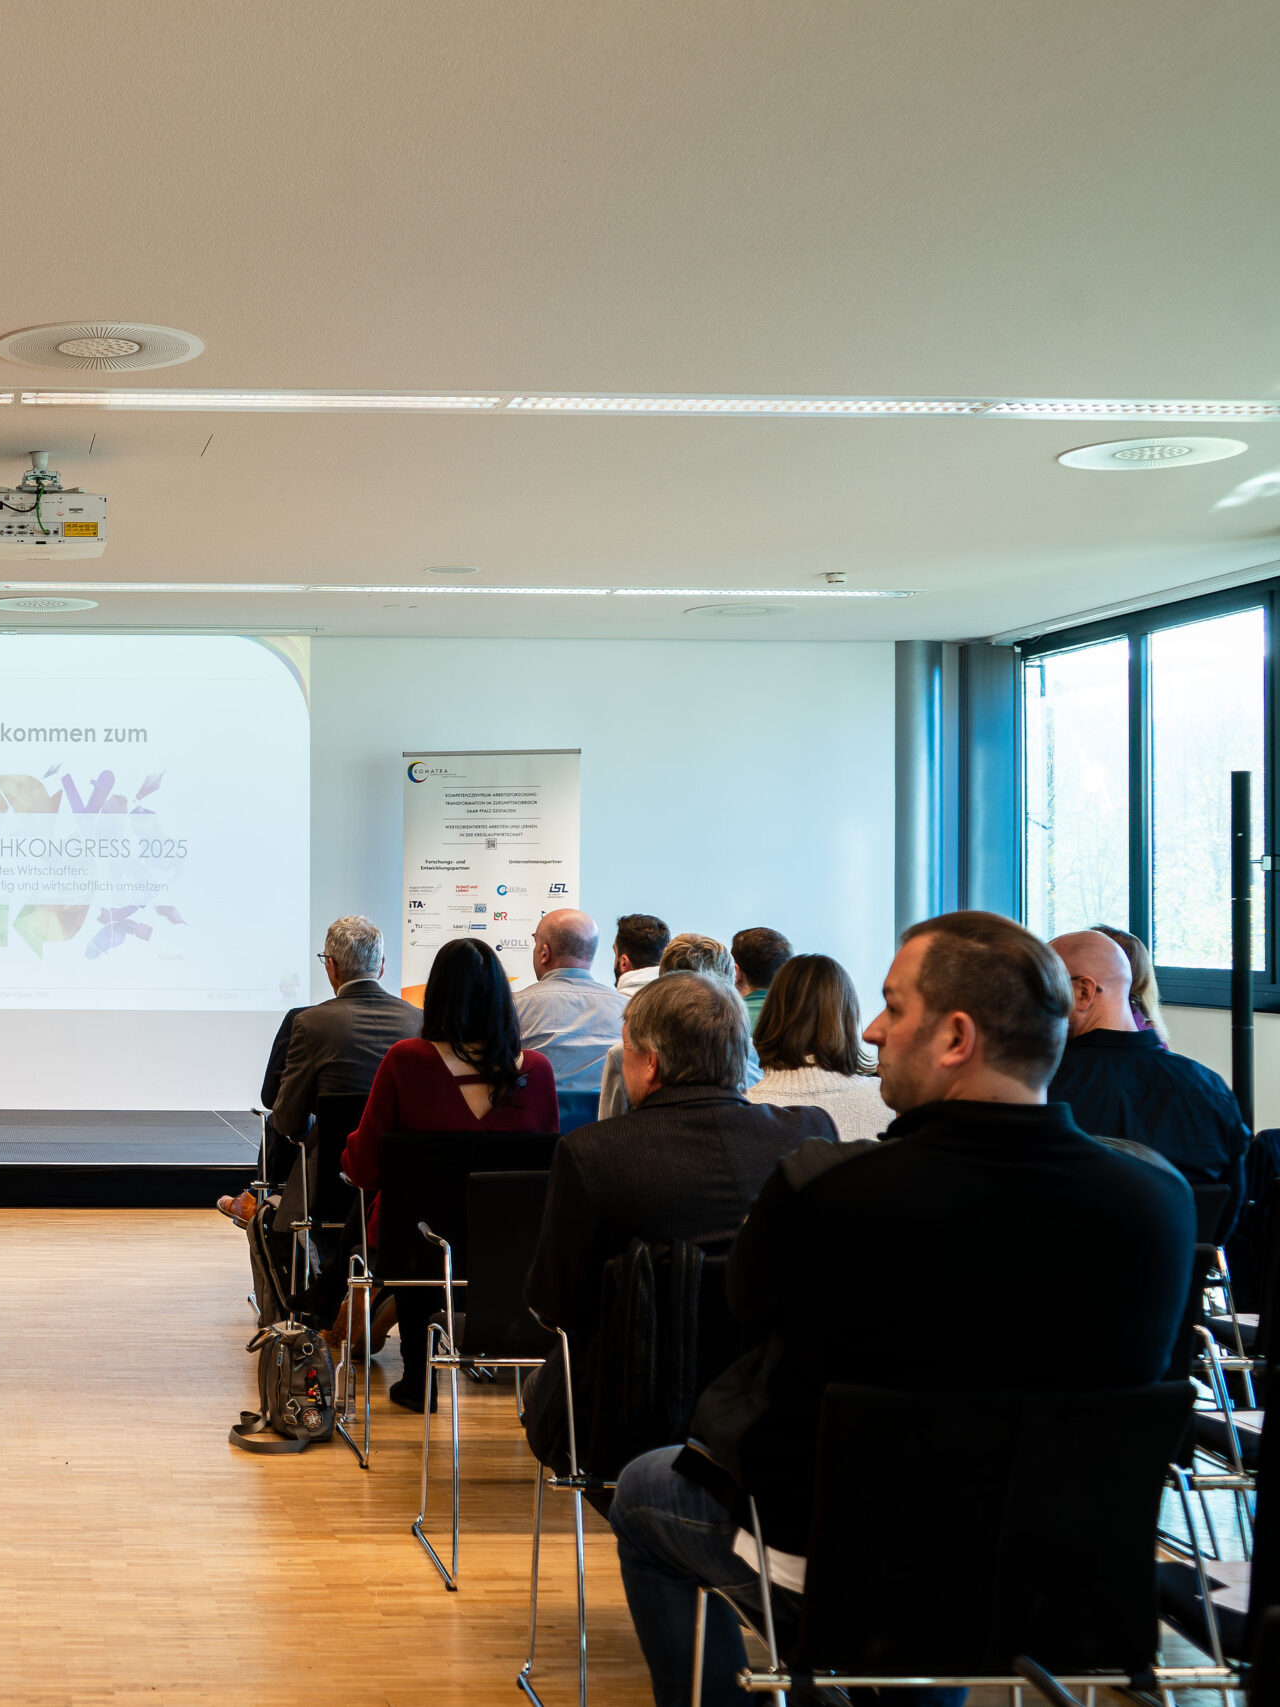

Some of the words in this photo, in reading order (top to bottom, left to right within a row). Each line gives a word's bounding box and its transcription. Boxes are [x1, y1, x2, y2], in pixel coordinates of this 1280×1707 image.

[103, 728, 148, 743] zum
[138, 837, 188, 859] 2025
[17, 864, 88, 876] Wirtschaften:
[17, 879, 40, 892] und
[42, 879, 114, 892] wirtschaftlich
[116, 881, 169, 893] umsetzen
[500, 939, 530, 947] WOLL
